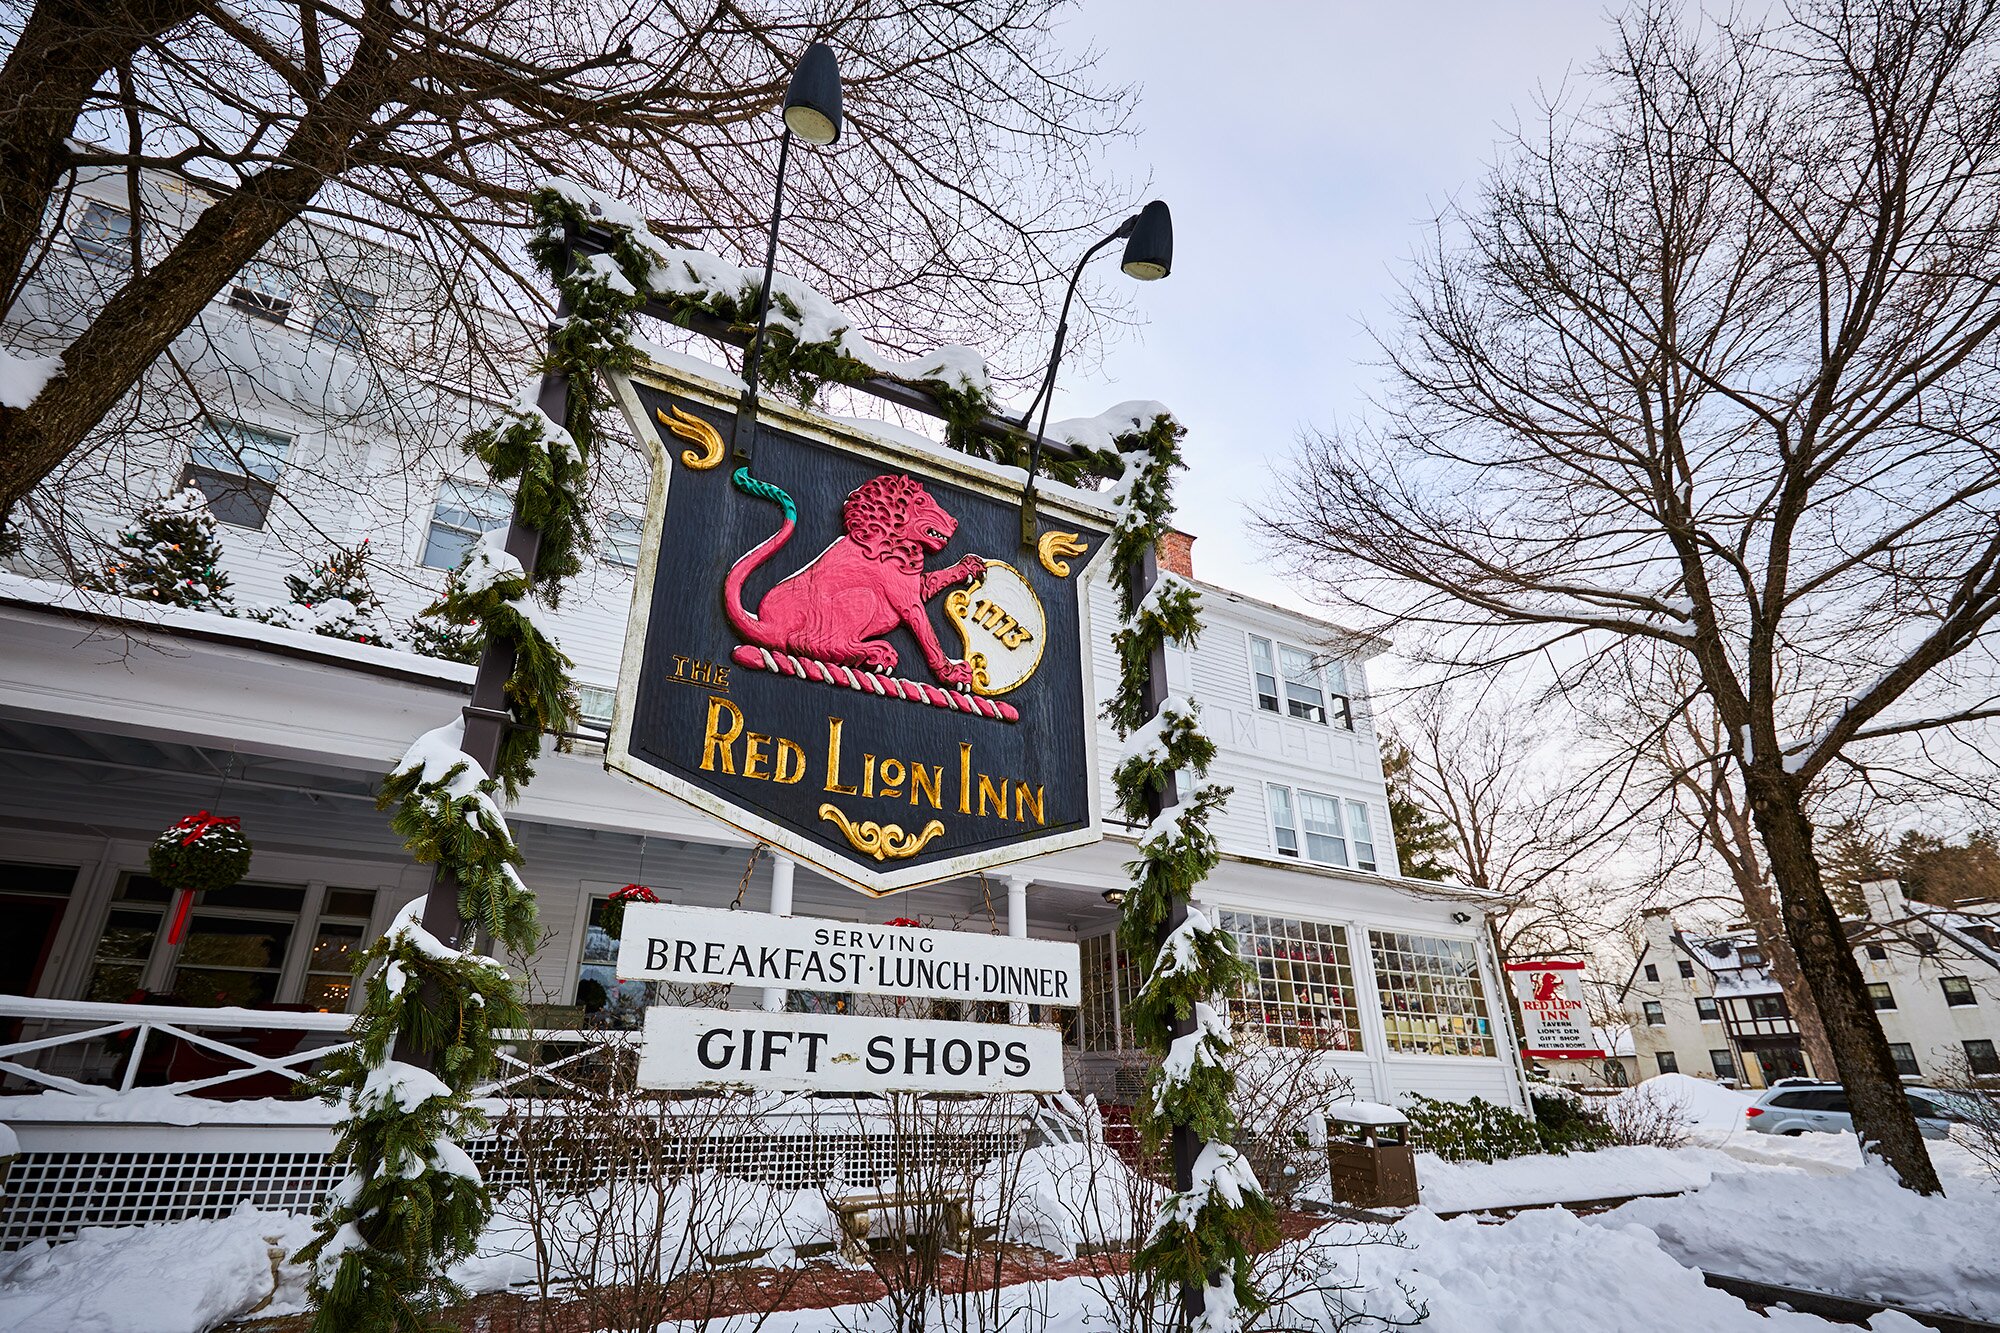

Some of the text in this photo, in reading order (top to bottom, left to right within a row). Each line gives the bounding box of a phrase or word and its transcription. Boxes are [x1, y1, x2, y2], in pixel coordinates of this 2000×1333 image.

[971, 598, 1034, 651] 1773
[672, 655, 731, 686] THE
[699, 695, 807, 784] RED
[958, 741, 1046, 826] INN
[814, 928, 935, 954] SERVING
[644, 937, 1069, 998] BREAKFAST LUNCH DINNER
[1523, 1000, 1582, 1010] RED LION
[1540, 1011, 1570, 1021] INN
[697, 1028, 1031, 1077] GIFT SHOPS
